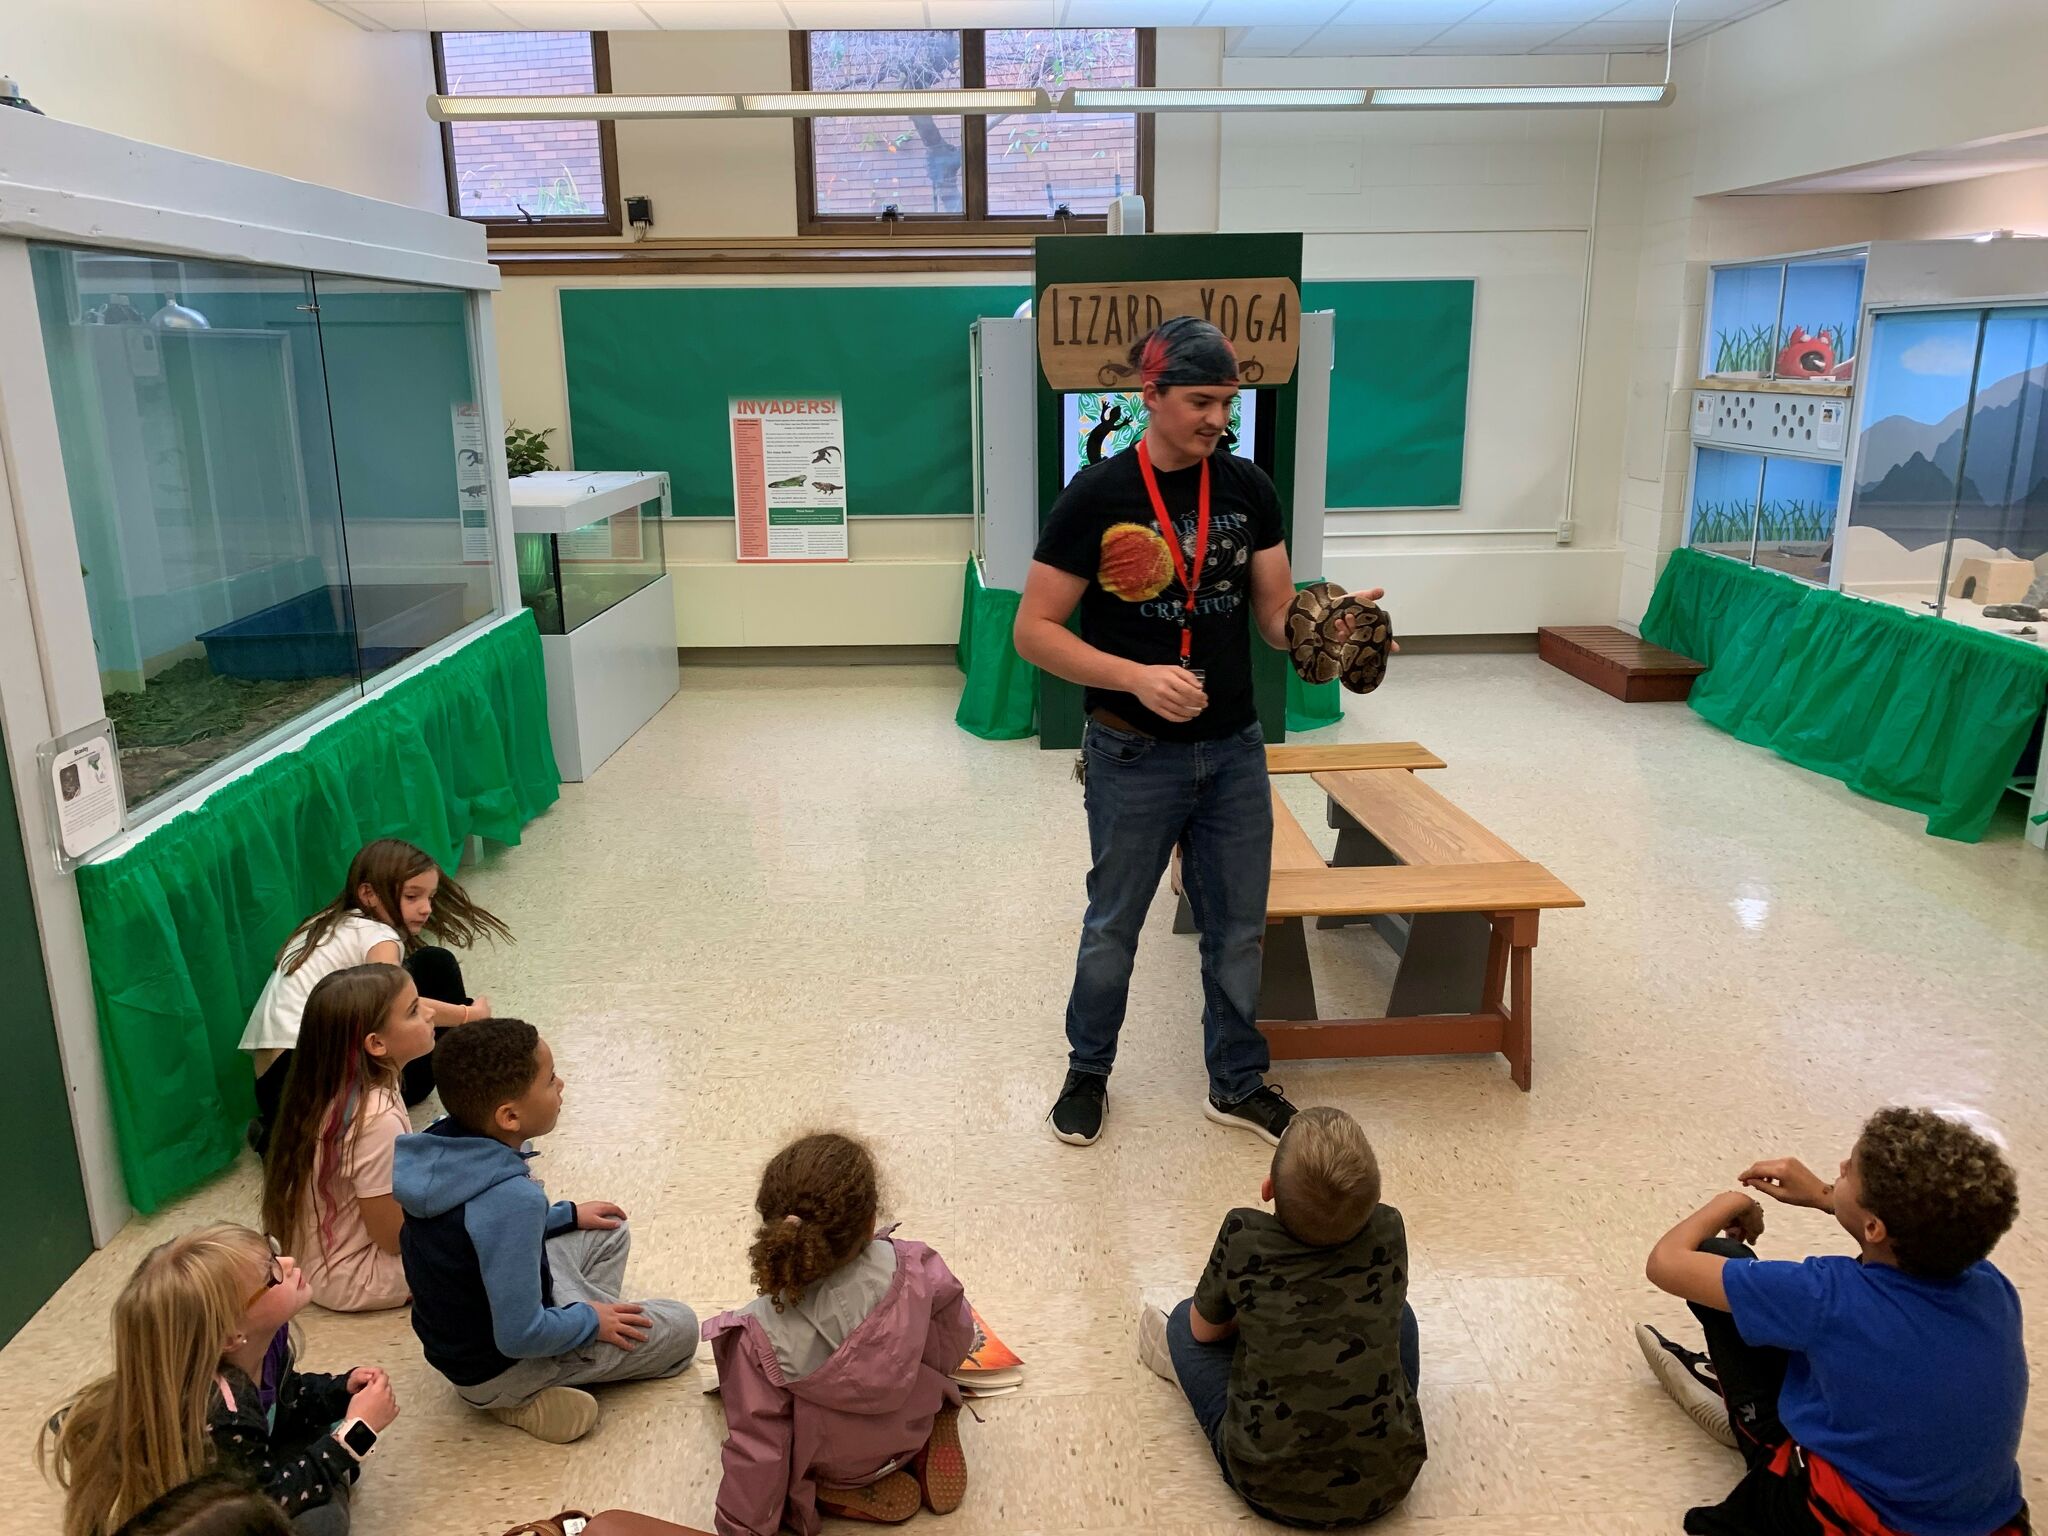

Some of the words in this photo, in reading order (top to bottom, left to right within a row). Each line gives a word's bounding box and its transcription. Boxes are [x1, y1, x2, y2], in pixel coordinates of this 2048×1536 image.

[1052, 288, 1162, 346] LIZARD
[1200, 286, 1287, 343] YOGA
[737, 400, 837, 415] INVADERS!
